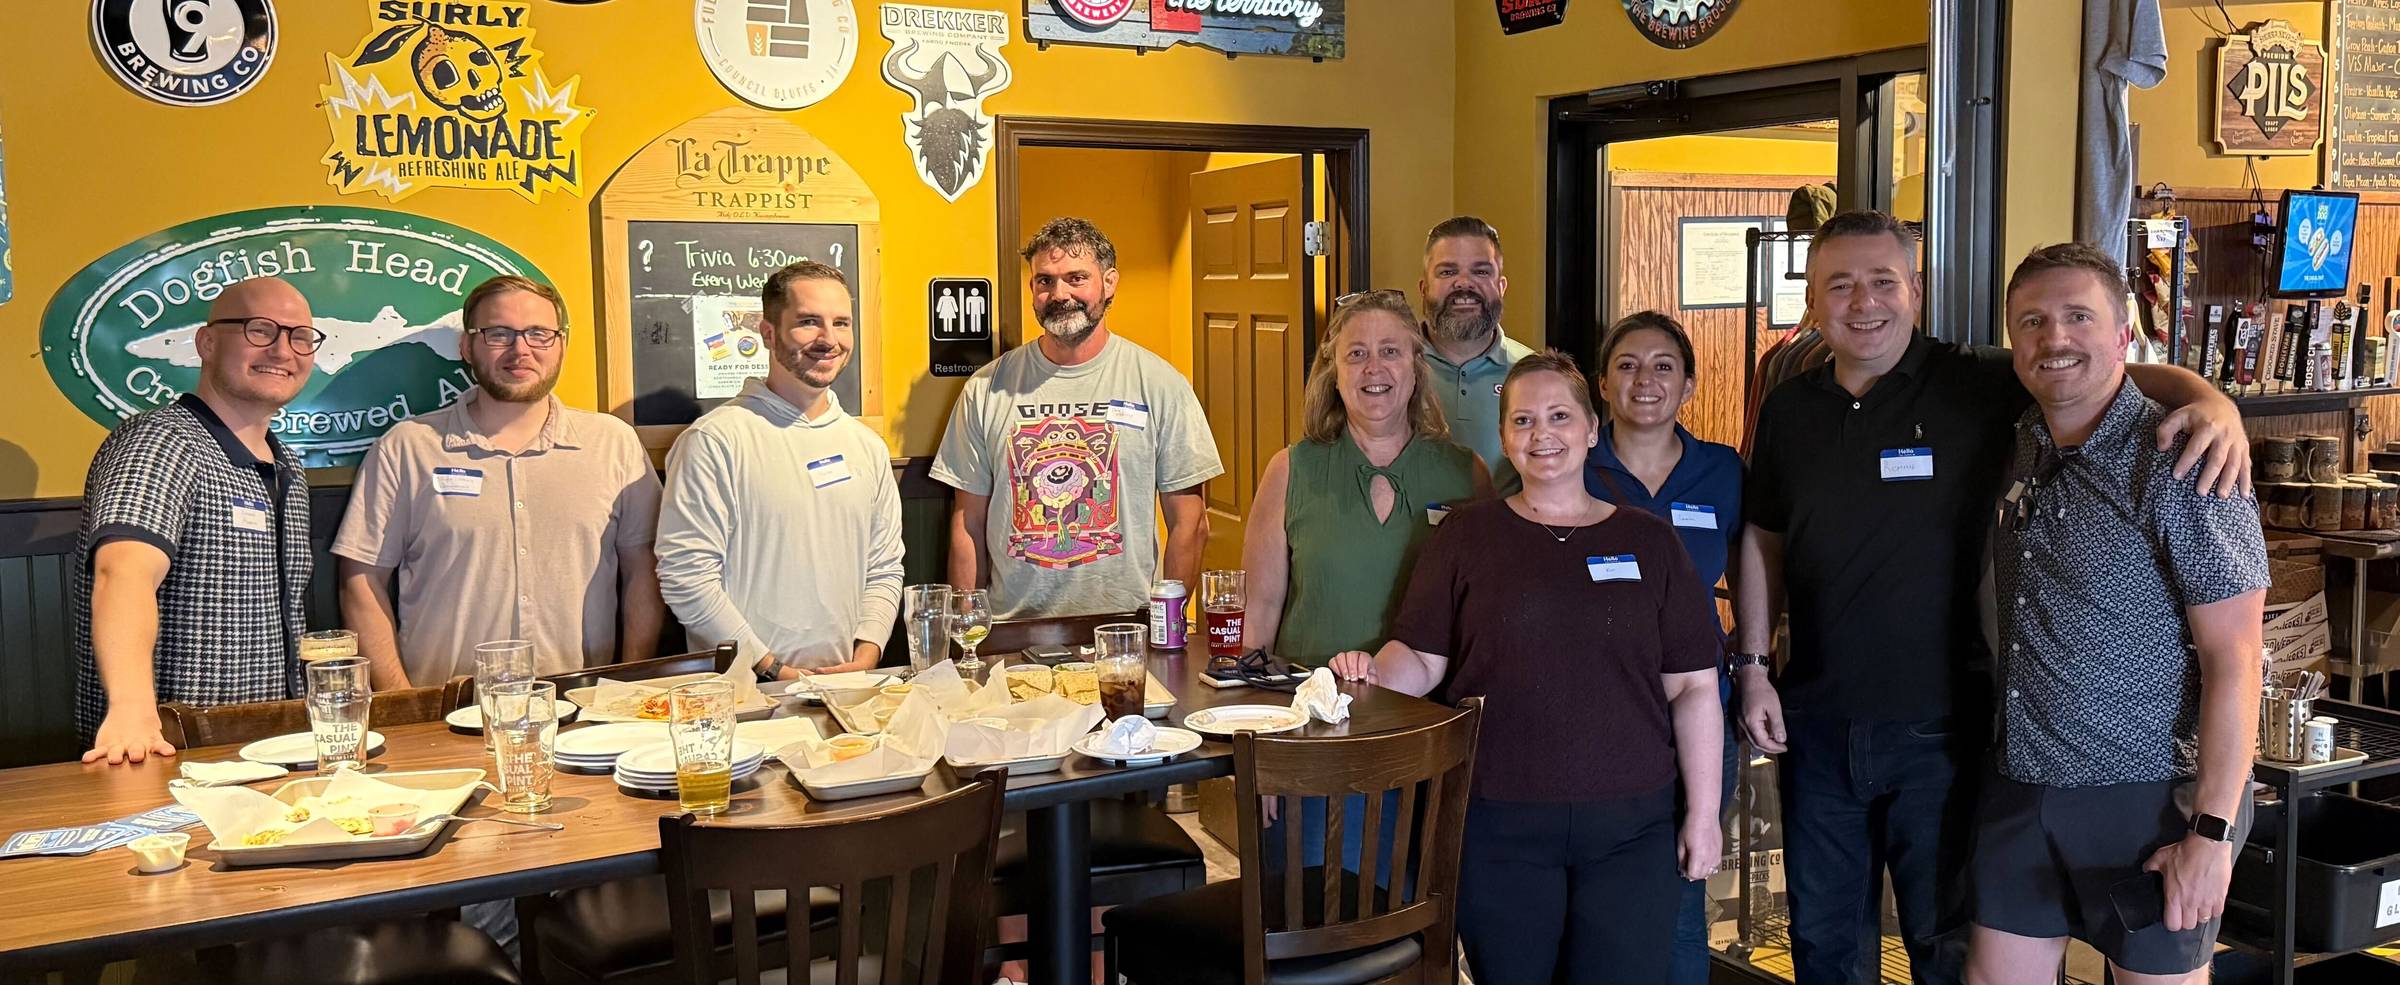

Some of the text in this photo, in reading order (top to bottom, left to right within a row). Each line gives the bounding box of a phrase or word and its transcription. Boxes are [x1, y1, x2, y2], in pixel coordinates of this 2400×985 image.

[378, 0, 527, 27] SURLY
[884, 7, 1004, 34] DREKKER
[1216, 0, 1323, 28] territory
[2336, 14, 2342, 26] 3
[174, 0, 211, 53] 9
[947, 32, 988, 41] COMPANY
[1648, 19, 1697, 41] BREWING
[2336, 36, 2341, 49] 4
[117, 42, 259, 94] BREWING CO
[2335, 59, 2340, 71] 5
[718, 58, 767, 97] COUNCIL
[773, 82, 817, 100] BLUFFS
[2334, 81, 2339, 94] 6
[2239, 60, 2308, 121] PILS
[356, 114, 566, 161] LEMONADE
[398, 161, 519, 181] REFRESHING ALE
[665, 137, 831, 189] La Trappe
[692, 191, 813, 209] TRAPPIST
[674, 240, 736, 269] Trivia
[119, 240, 470, 329] Dogfish Head
[692, 271, 732, 294] Every
[2305, 360, 2315, 386] BOSS
[270, 395, 415, 435] Brewed
[1017, 402, 1111, 418] GOOSE
[1210, 627, 1241, 635] CASUAL
[1226, 618, 1242, 627] THE
[1223, 634, 1241, 643] PINT
[332, 724, 358, 733] THE
[1721, 854, 1767, 871] BREING
